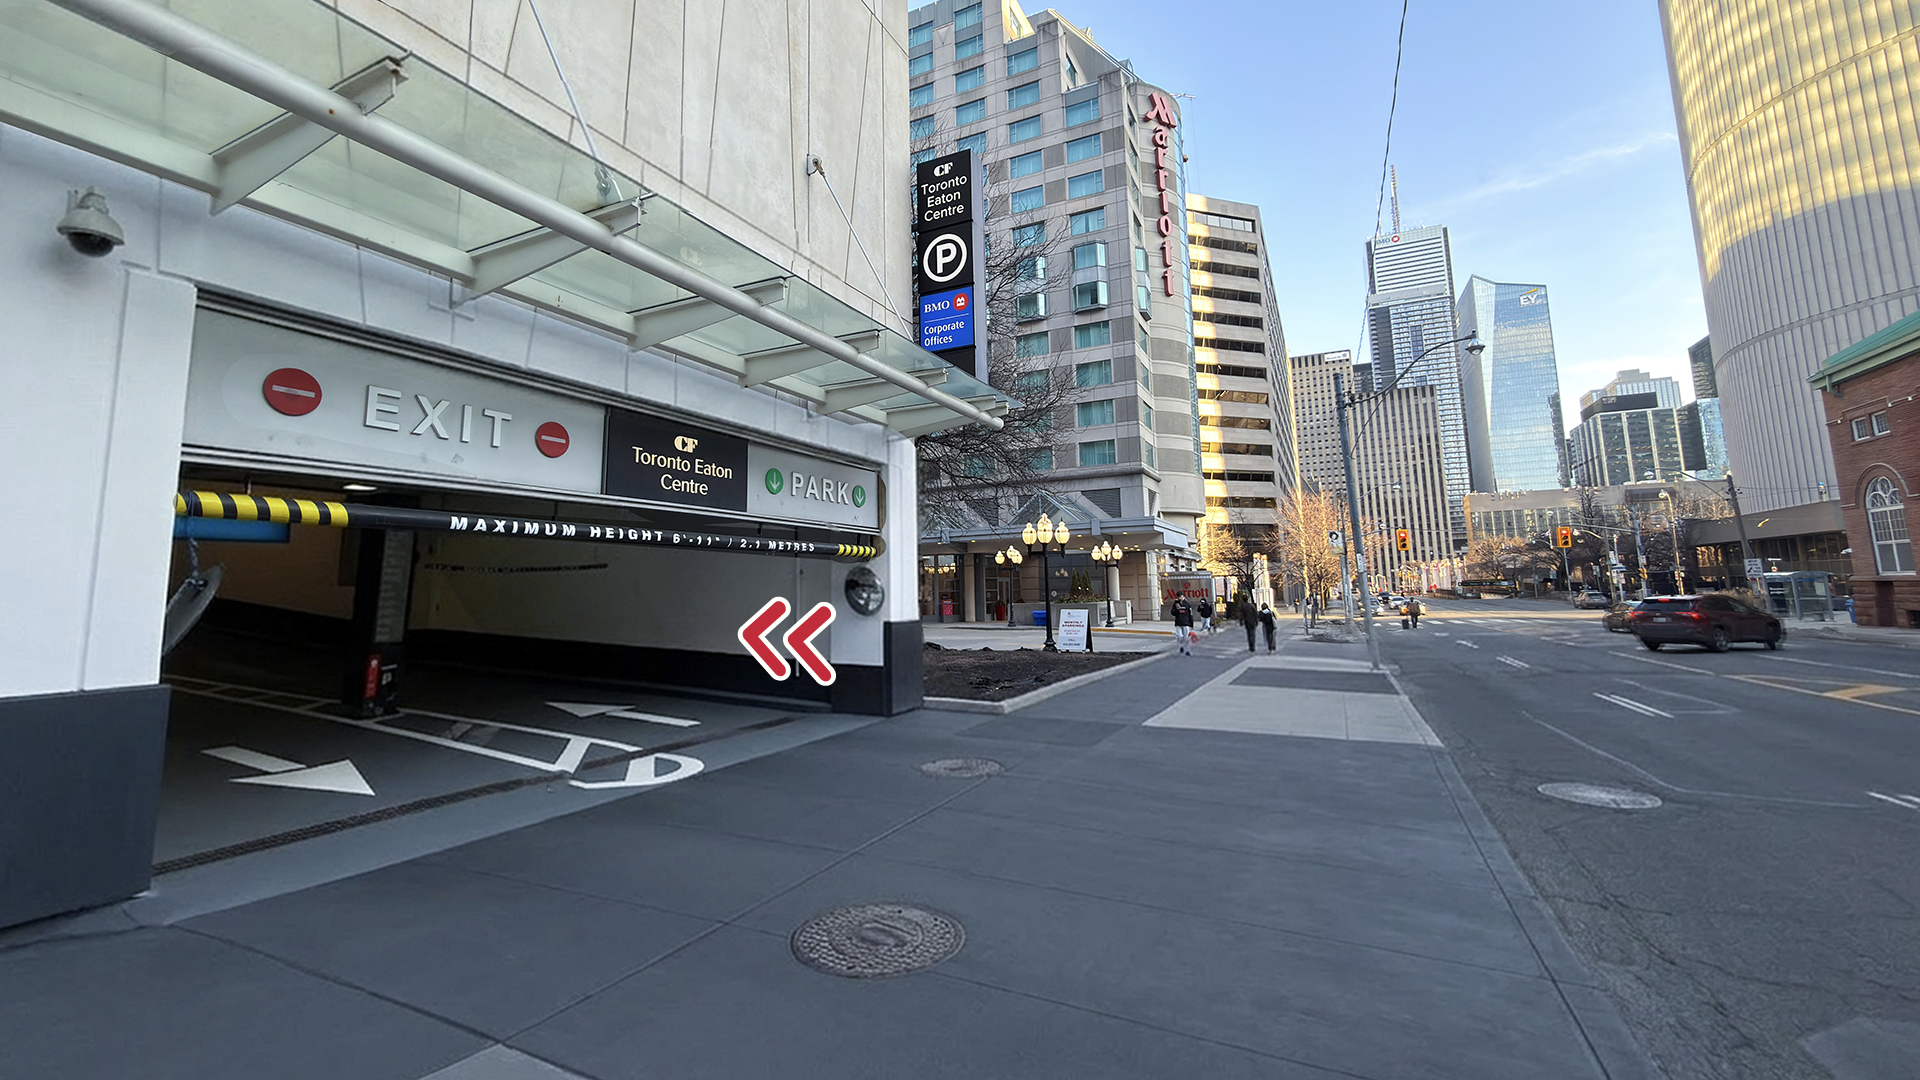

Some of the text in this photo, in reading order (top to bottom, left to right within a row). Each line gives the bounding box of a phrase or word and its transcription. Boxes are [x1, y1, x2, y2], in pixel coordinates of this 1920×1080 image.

[933, 161, 953, 177] CF
[920, 175, 968, 195] Toronto
[1144, 91, 1177, 297] Marriott
[927, 191, 961, 208] Eaton
[924, 204, 965, 222] Centre
[924, 300, 950, 313] BMO
[1520, 294, 1538, 306] EY
[924, 321, 965, 335] Corporate
[924, 335, 953, 347] Offices
[363, 384, 513, 449] EXIT
[674, 435, 699, 454] CF
[632, 445, 733, 479] Toronto Eaton
[660, 473, 709, 496] Centre
[791, 470, 850, 506] PARK
[449, 515, 577, 537] MAXIMUM
[589, 525, 664, 543] HEIGHT
[739, 537, 761, 549] 2.1
[767, 539, 815, 553] METRES
